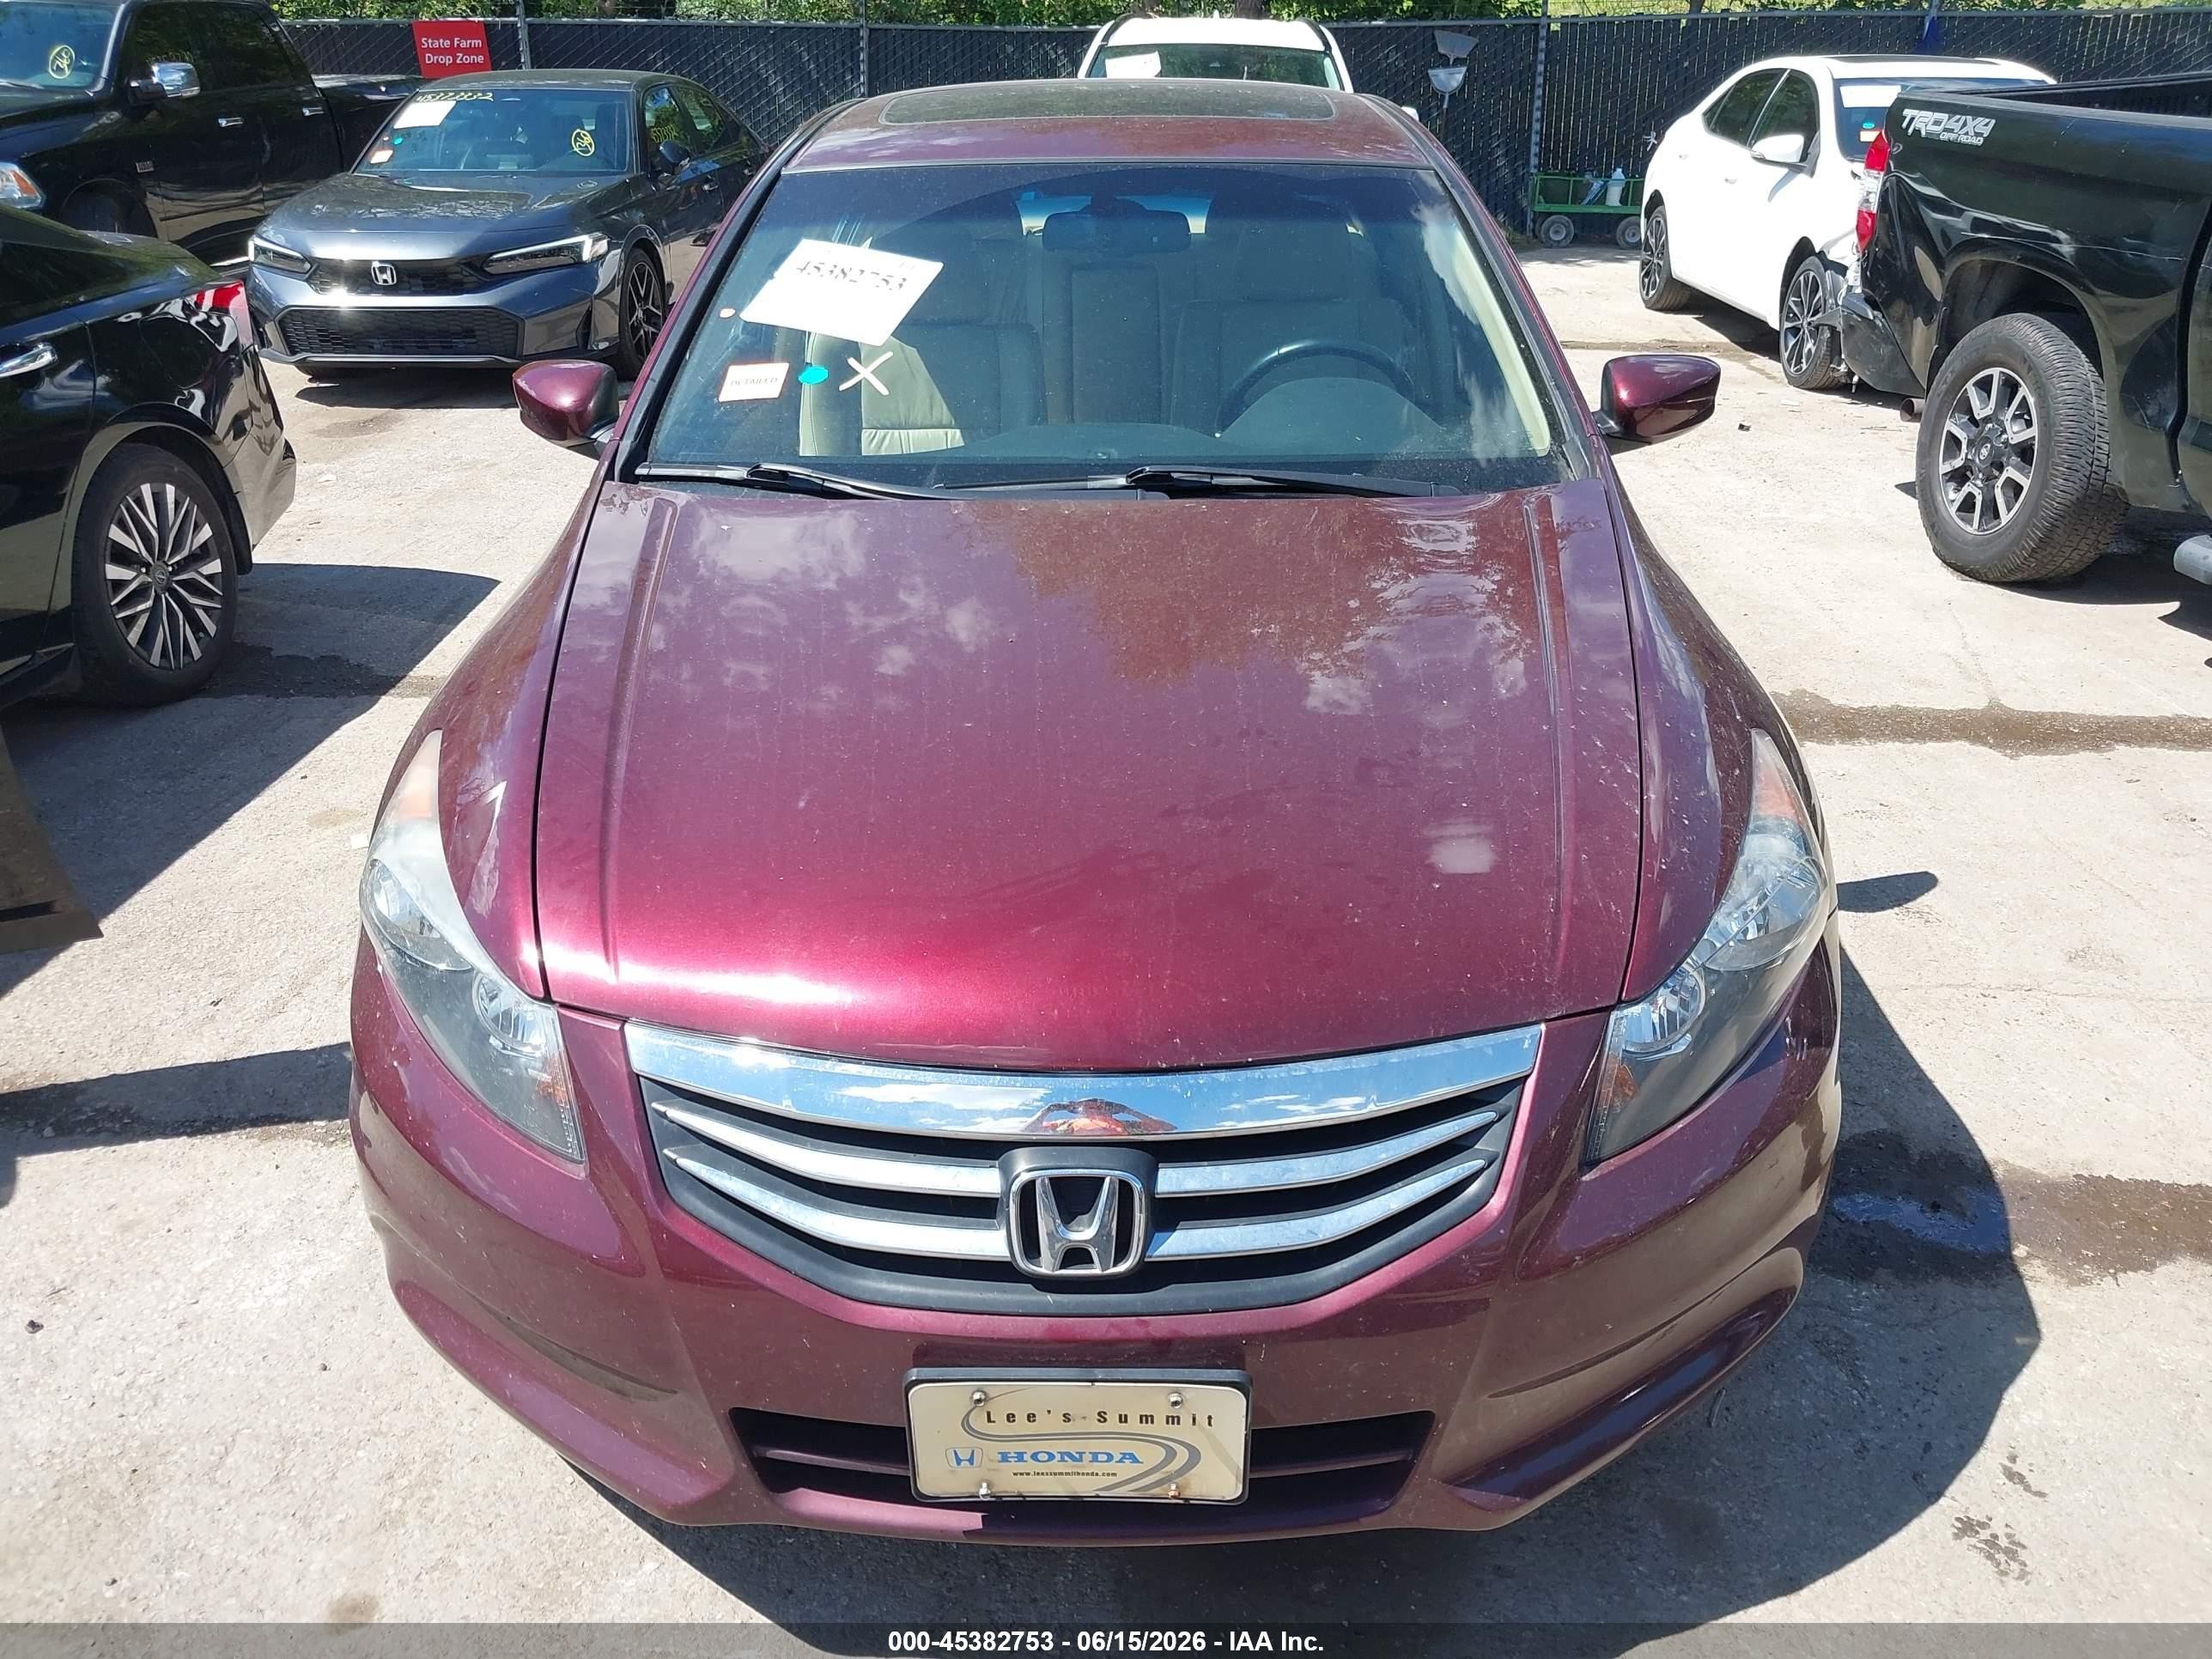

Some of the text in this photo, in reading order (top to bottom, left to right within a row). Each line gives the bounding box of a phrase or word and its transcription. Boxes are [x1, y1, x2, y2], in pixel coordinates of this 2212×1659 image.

[421, 38, 482, 48] State Farm
[425, 53, 484, 66] Drop Zone
[1940, 131, 1984, 146] OFF ROAD
[986, 1409, 1213, 1427] Lee's Summit
[997, 1451, 1144, 1464] HONDA
